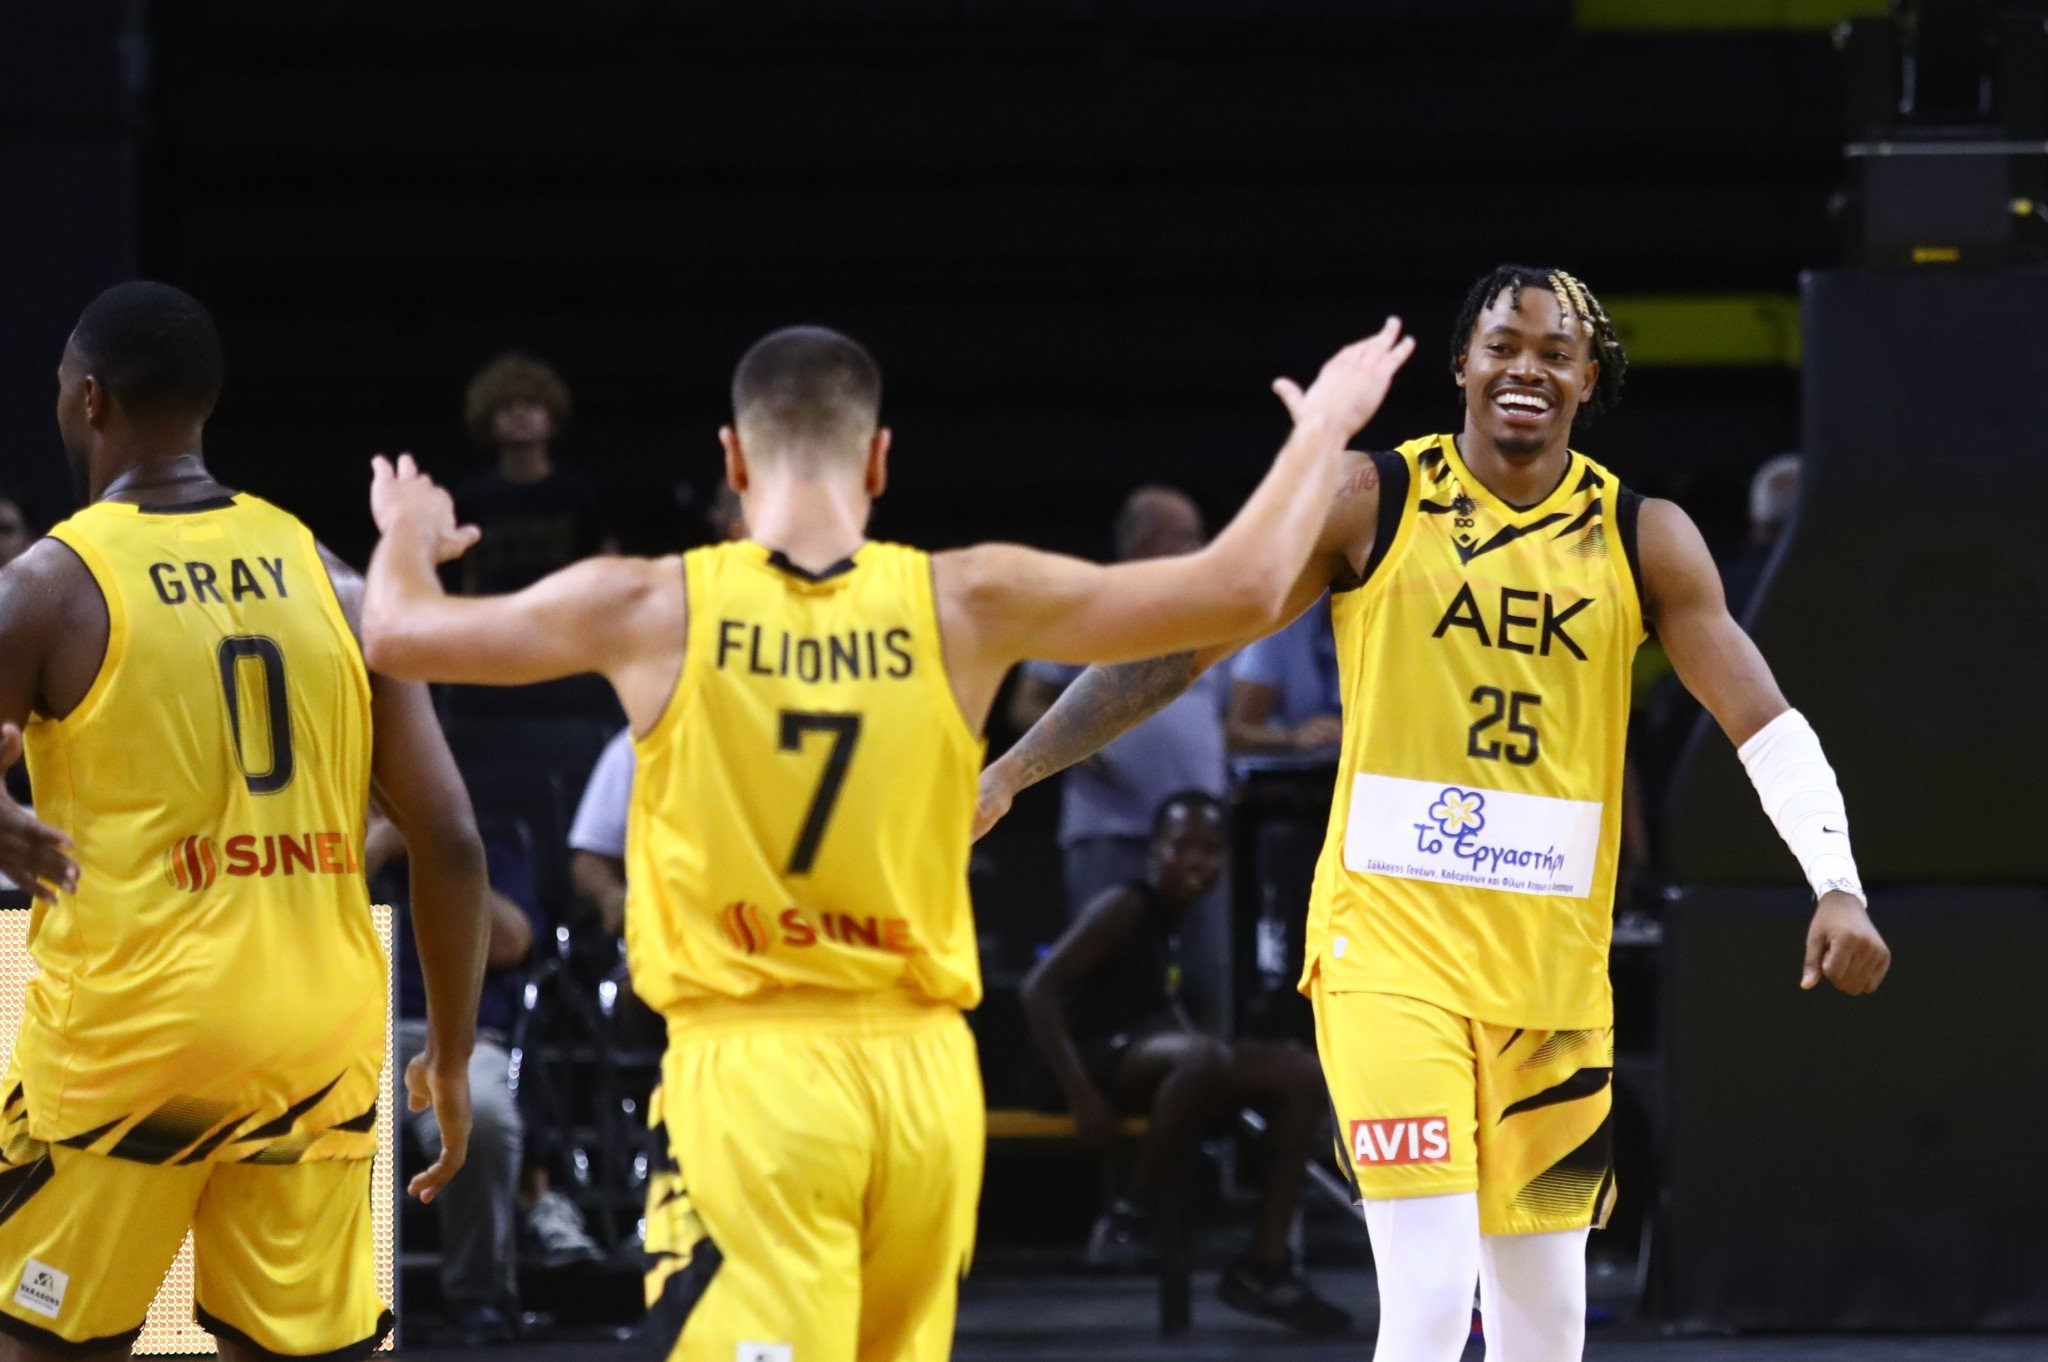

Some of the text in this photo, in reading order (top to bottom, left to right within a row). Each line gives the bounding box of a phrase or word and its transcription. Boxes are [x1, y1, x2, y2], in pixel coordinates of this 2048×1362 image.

[149, 557, 288, 606] GRAY
[1431, 581, 1596, 661] AEK
[715, 619, 914, 684] FLIONIS
[217, 634, 294, 796] 0
[1467, 684, 1542, 767] 25
[776, 708, 863, 876] 7
[1354, 1120, 1448, 1161] AVIS
